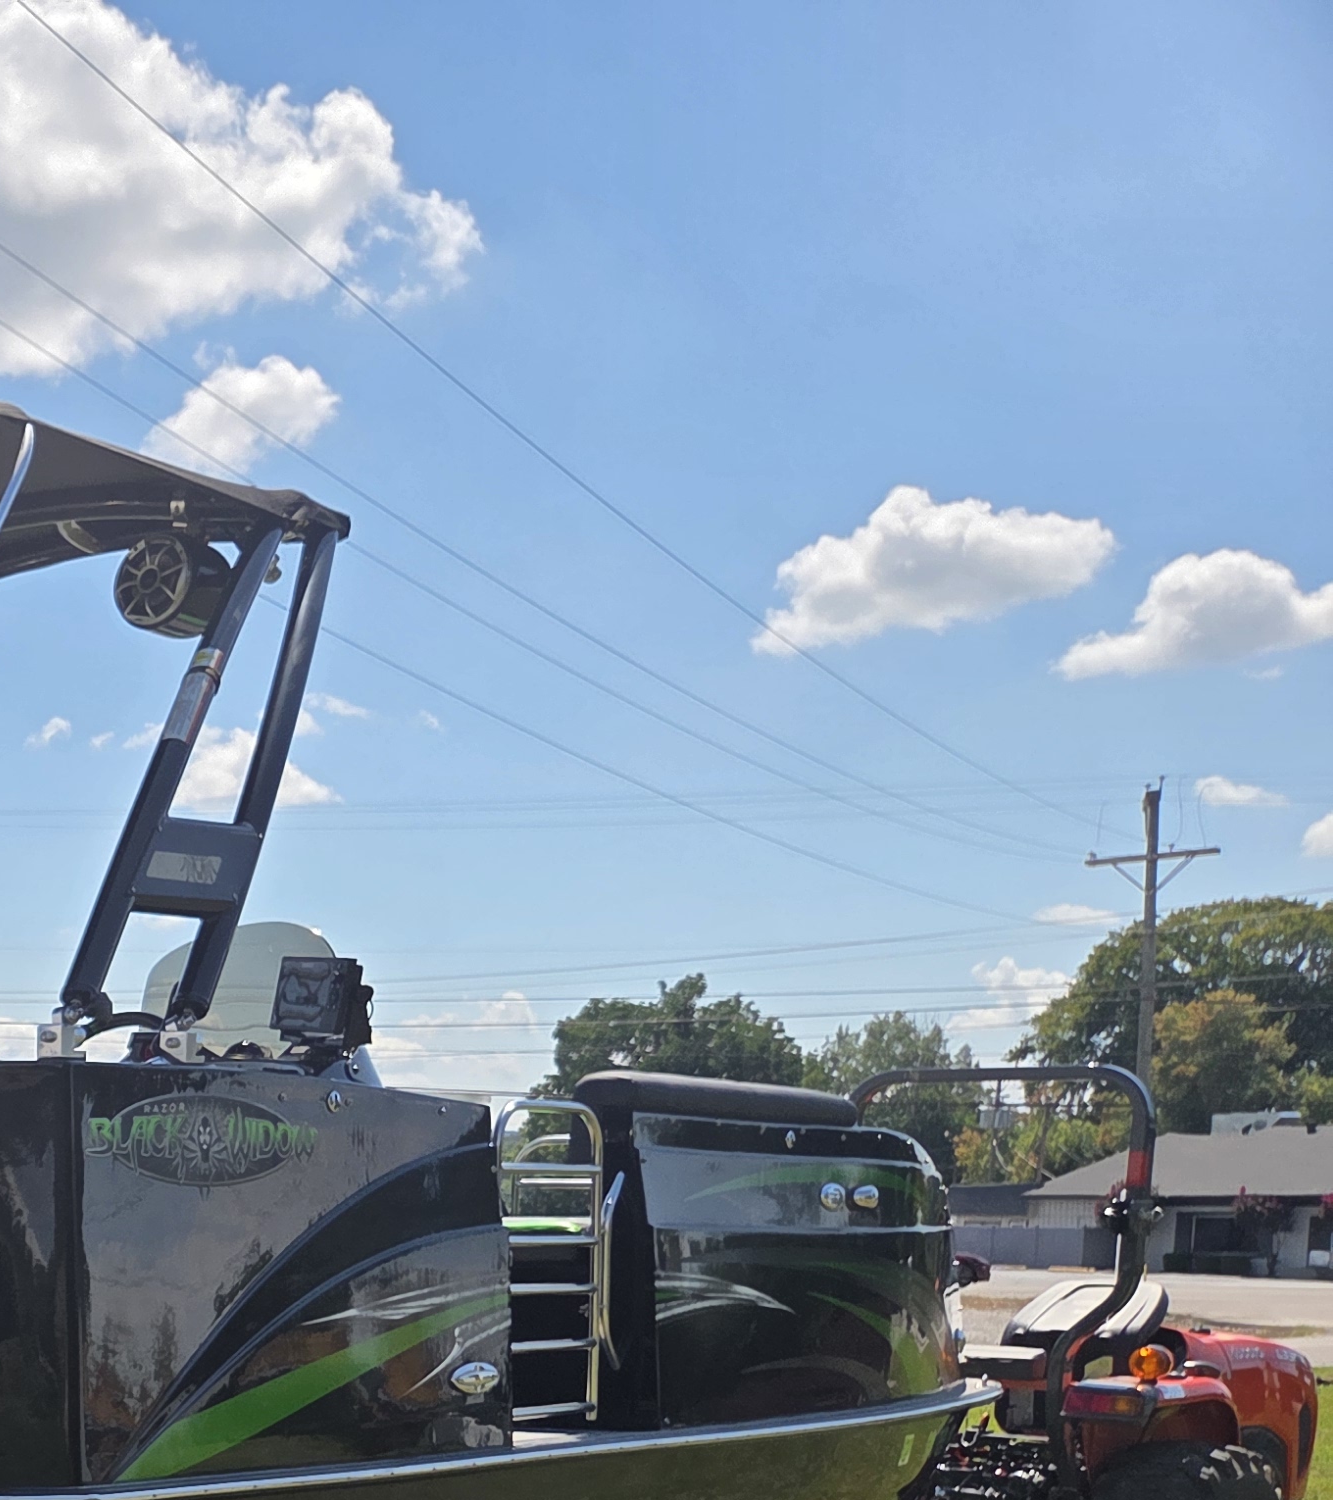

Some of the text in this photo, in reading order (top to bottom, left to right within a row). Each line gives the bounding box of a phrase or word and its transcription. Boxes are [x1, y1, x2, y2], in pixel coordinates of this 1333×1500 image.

[143, 1102, 186, 1113] RAZOR
[85, 1106, 319, 1178] BLACK WIDOW
